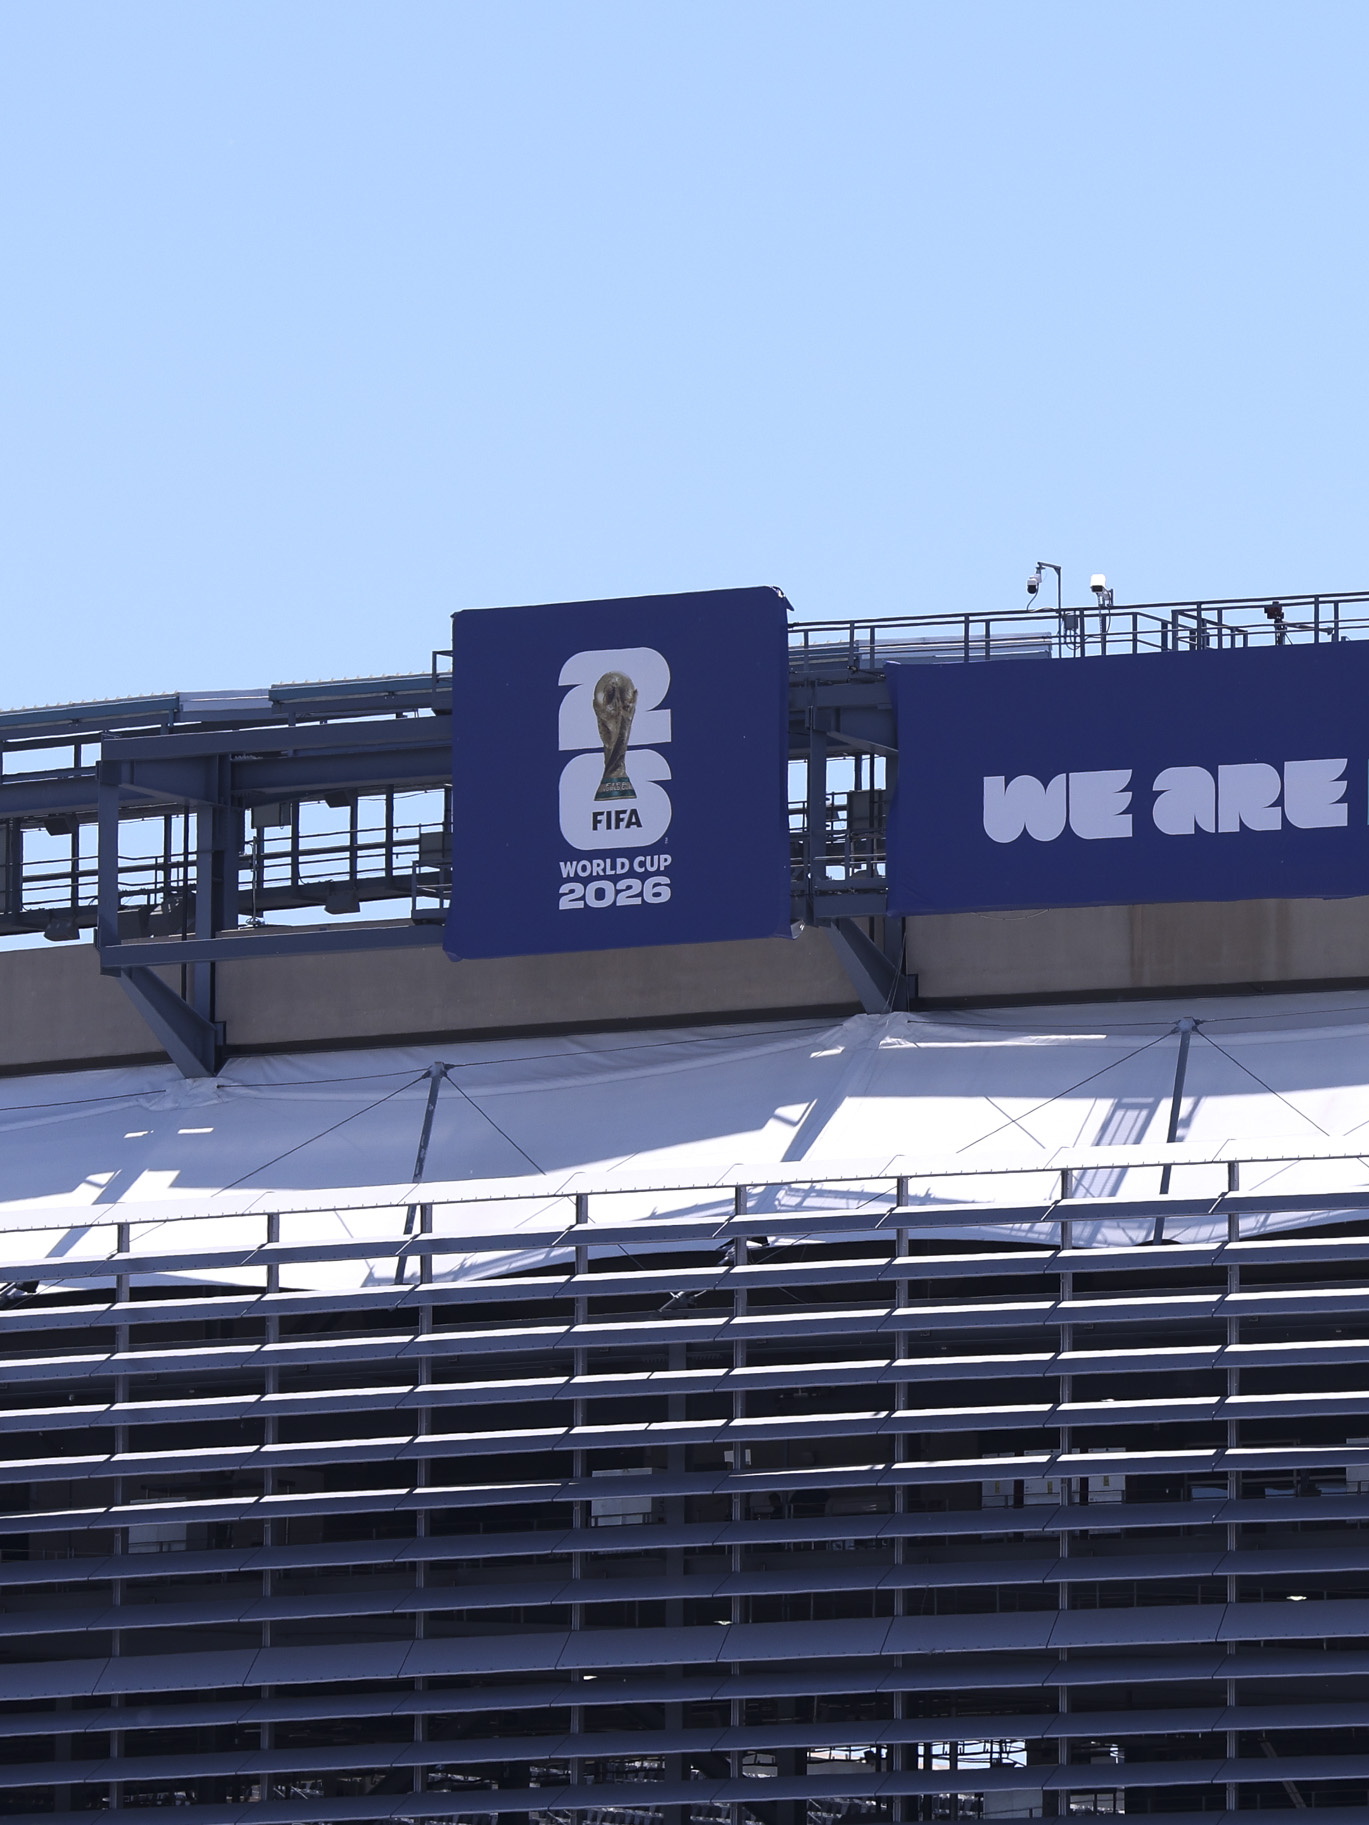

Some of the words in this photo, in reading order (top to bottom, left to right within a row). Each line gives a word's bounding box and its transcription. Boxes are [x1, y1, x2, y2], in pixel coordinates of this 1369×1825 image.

[592, 808, 643, 832] FIFA
[983, 768, 1133, 845] WE
[558, 857, 630, 878] WORLD
[633, 854, 672, 874] CUP
[558, 876, 672, 910] 2026
